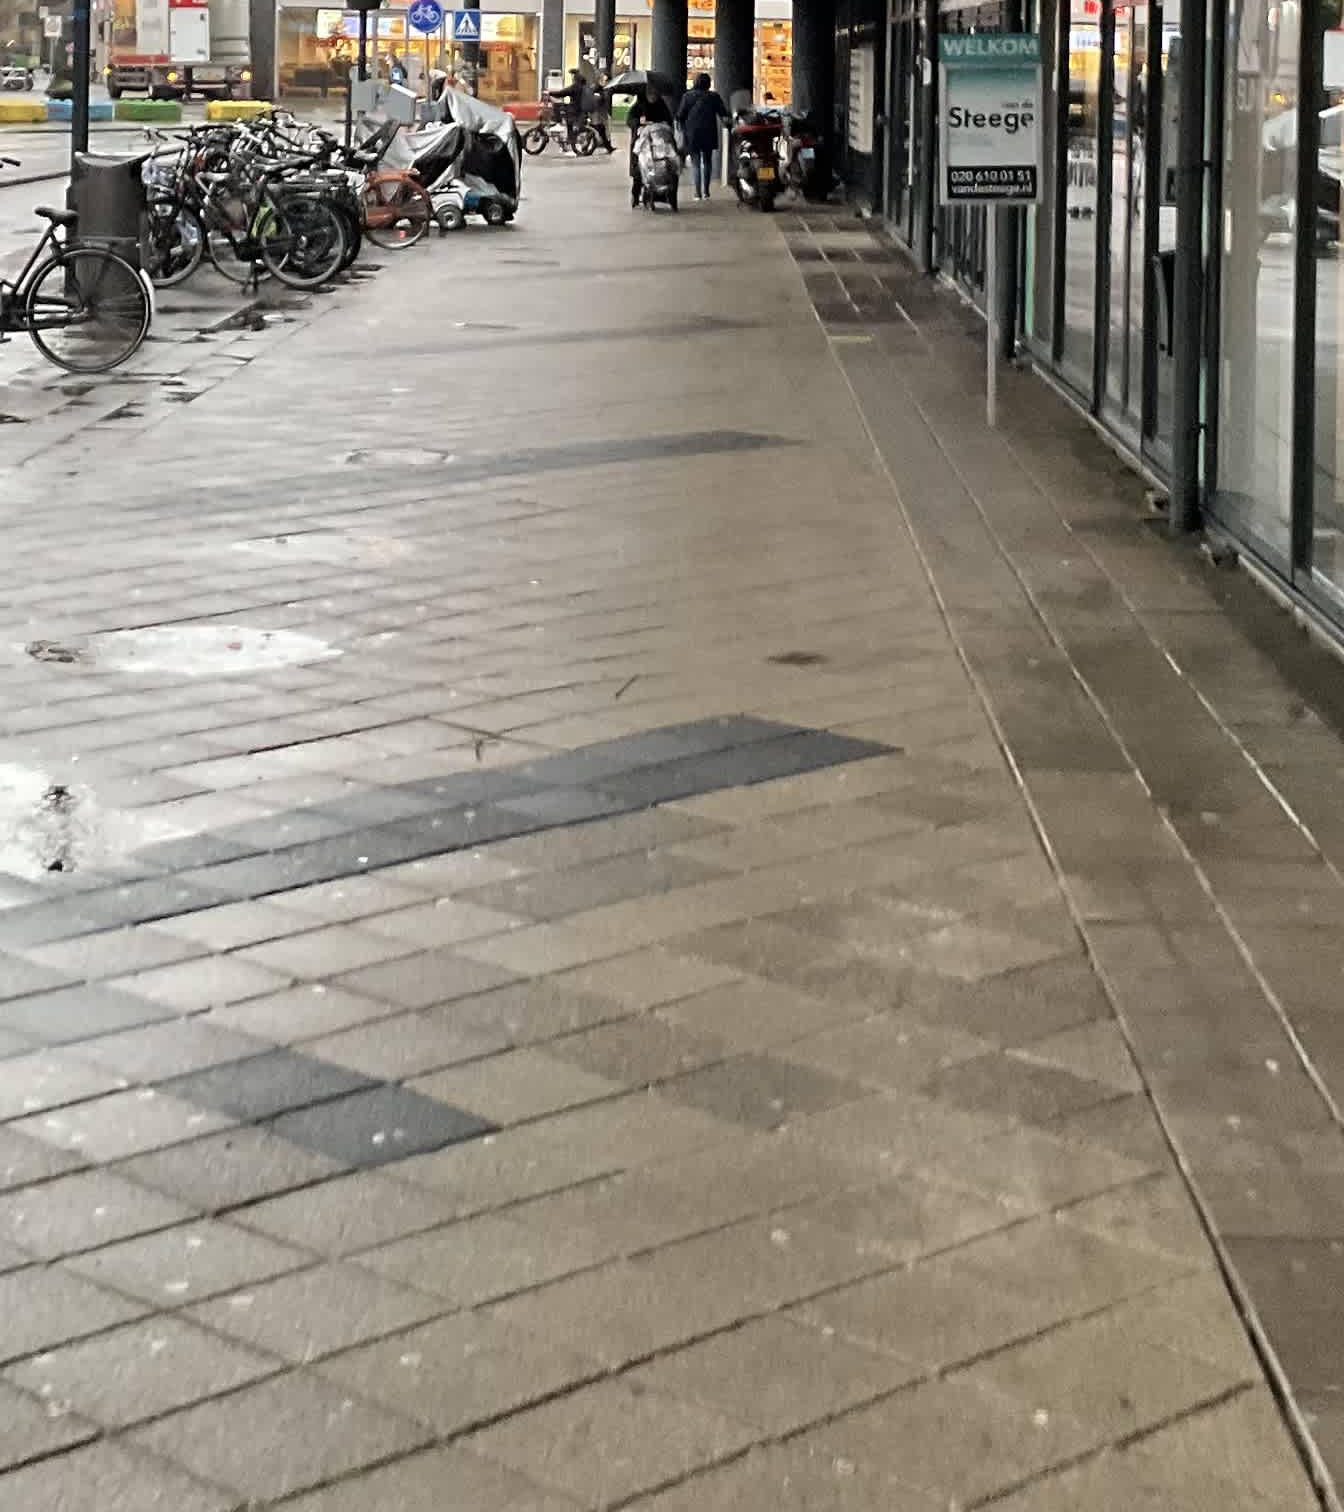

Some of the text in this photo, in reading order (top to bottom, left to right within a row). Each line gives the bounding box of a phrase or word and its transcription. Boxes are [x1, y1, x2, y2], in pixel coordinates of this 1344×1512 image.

[943, 38, 1039, 57] WELKOM
[947, 106, 1034, 135] Steege
[951, 170, 973, 183] 020
[975, 170, 998, 183] 610
[1000, 170, 1014, 183] 01
